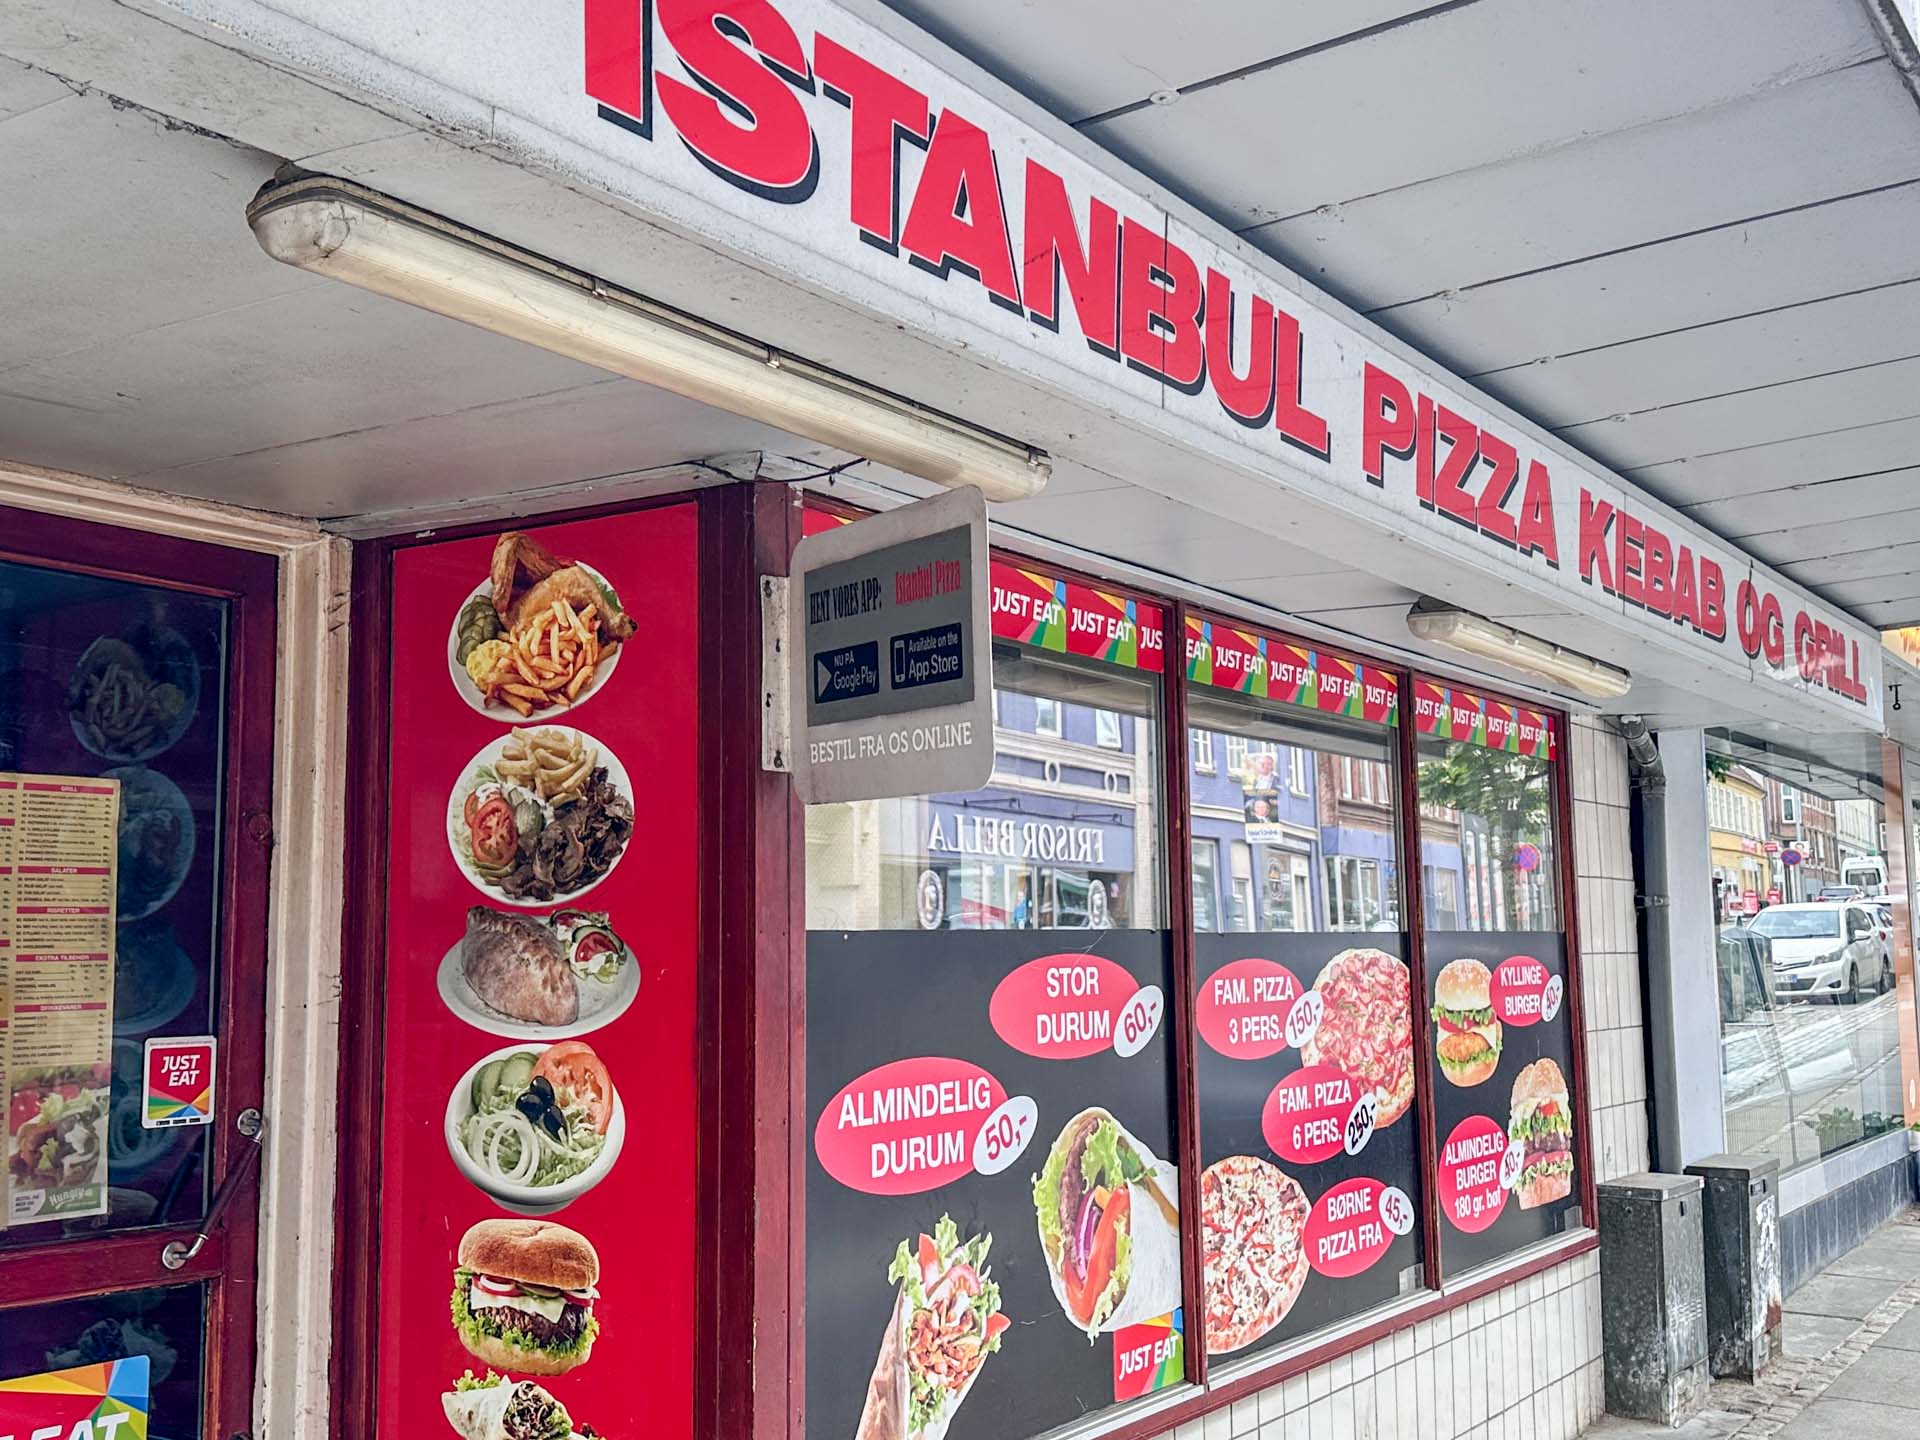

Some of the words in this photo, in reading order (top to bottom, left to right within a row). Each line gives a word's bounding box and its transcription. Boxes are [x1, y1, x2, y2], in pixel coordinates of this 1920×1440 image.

[584, 0, 1331, 463] ISTANBUL
[1362, 361, 1559, 570] PIZZA
[1578, 486, 1726, 643] KEBAB
[1736, 578, 1784, 669] OG
[1794, 610, 1867, 704] GRILL
[935, 560, 961, 594] Pizza
[810, 589, 830, 625] HENT
[832, 581, 859, 618] VORES
[861, 577, 882, 613] APP:
[992, 587, 1031, 621] JUST
[1032, 598, 1061, 626] EAT
[1070, 608, 1104, 636] JUST
[1107, 618, 1134, 643] EAT
[908, 636, 936, 653] Available
[938, 635, 947, 647] on
[947, 631, 959, 645] the
[1186, 639, 1209, 661] EAT
[834, 653, 844, 667] NU
[908, 658, 930, 682] App
[931, 654, 959, 675] Store
[1216, 646, 1242, 670] JUST
[1244, 655, 1265, 674] EAT
[1271, 660, 1294, 683] JUST
[1296, 668, 1315, 687] EAT
[834, 667, 860, 693] Google
[861, 665, 876, 689] Play
[1320, 673, 1342, 695] JUST
[1343, 680, 1362, 699] EAT
[1366, 684, 1385, 706] JUST
[1415, 697, 1433, 716] JUST
[1434, 703, 1450, 720] EAT
[1453, 708, 1470, 725] JUST
[1470, 711, 1485, 729] EAT
[1488, 716, 1503, 733] JUST
[1504, 719, 1518, 736] EAT
[1520, 724, 1534, 742] JUST
[1535, 728, 1546, 743] EAT
[810, 738, 856, 764] BESTIL
[860, 734, 885, 757] FRA
[889, 730, 908, 753] OS
[912, 721, 972, 751] ONLINE
[1046, 966, 1099, 998] STOR
[1214, 978, 1250, 1006] FAM.
[1254, 975, 1294, 1003] PIZZA
[1500, 965, 1542, 987] KYLLINGE
[1289, 1001, 1321, 1041] 150,-
[1505, 994, 1540, 1017] BURGER
[1036, 1010, 1110, 1045] DURUM
[1123, 1001, 1157, 1044] 60,-
[1229, 1017, 1239, 1045] 3
[1241, 1014, 1283, 1043] PERS.
[161, 1054, 200, 1074] JUST
[168, 1070, 200, 1087] EAT
[837, 1076, 991, 1130] ALMINDELIG
[1279, 1086, 1312, 1114] FAM.
[1314, 1079, 1352, 1108] PIZZA
[985, 1113, 1028, 1161] 50,-
[1292, 1125, 1301, 1150] 6
[1304, 1117, 1342, 1147] PERS.
[1348, 1103, 1376, 1150] 250,-
[871, 1130, 965, 1179] DURUM
[1445, 1131, 1504, 1166] ALMINDELIG
[1455, 1159, 1497, 1191] BURGER
[1327, 1187, 1372, 1223] BØRNE
[1384, 1194, 1408, 1230] 45,-
[1454, 1194, 1471, 1219] 180
[1473, 1195, 1485, 1218] gr.
[1318, 1230, 1356, 1264] PIZZA
[1358, 1221, 1384, 1251] FRA
[1119, 1344, 1152, 1381] JUST
[1154, 1335, 1179, 1365] EAT
